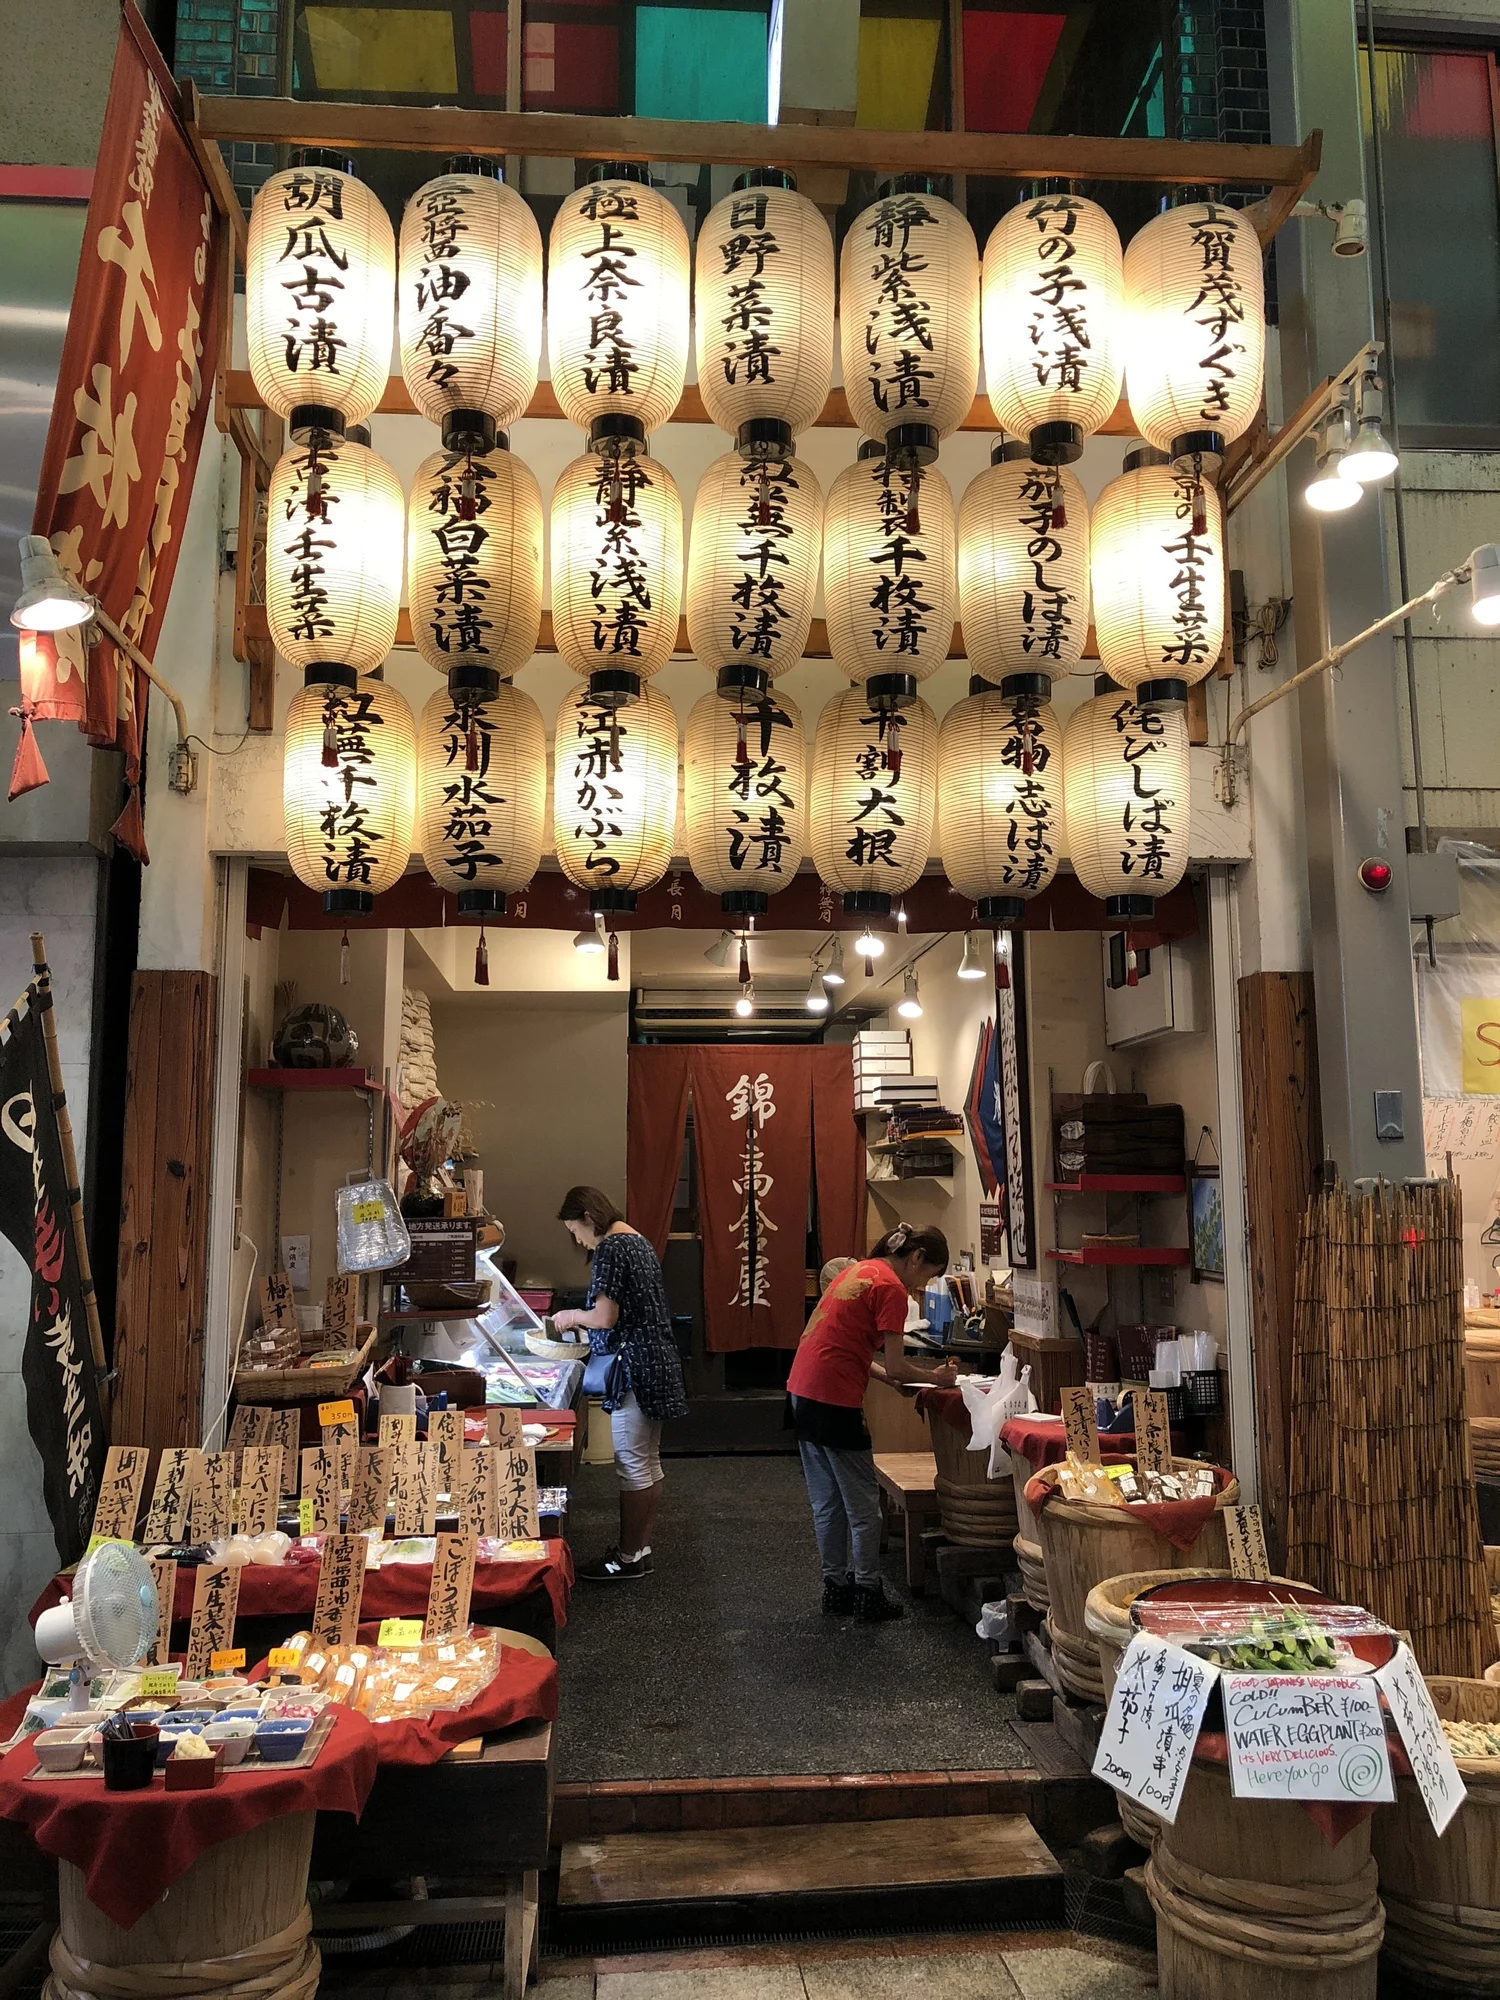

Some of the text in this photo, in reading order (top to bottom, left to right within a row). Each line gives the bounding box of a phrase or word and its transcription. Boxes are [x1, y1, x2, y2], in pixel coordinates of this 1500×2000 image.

[277, 172, 348, 375] 胡瓜古漬
[580, 185, 645, 396] 極上奈良漬
[719, 193, 782, 386] 日野菜漬
[865, 196, 941, 414] 静紫浅漬
[1026, 196, 1092, 394] 竹の子浅漬
[1184, 204, 1247, 422] 上賀茂すぐき
[869, 457, 936, 656] 特製千枚漬
[1016, 467, 1076, 661] 茄子のしば漬
[728, 697, 796, 874] 千枚漬
[1001, 697, 1052, 891] 名物志ば漬
[1111, 700, 1172, 881] 侘びしば漬
[667, 880, 685, 921] 長月
[102, 1449, 138, 1539] 胡瓜浅漬
[153, 1449, 190, 1542] 半割大根漬
[1102, 1753, 1132, 1788] 200円
[1118, 1649, 1151, 1745] 水茄子
[1233, 1722, 1288, 1750] WATER
[1286, 1719, 1360, 1746] EGGPLANT
[1246, 1765, 1284, 1789] Here
[1138, 1776, 1172, 1811] 100円
